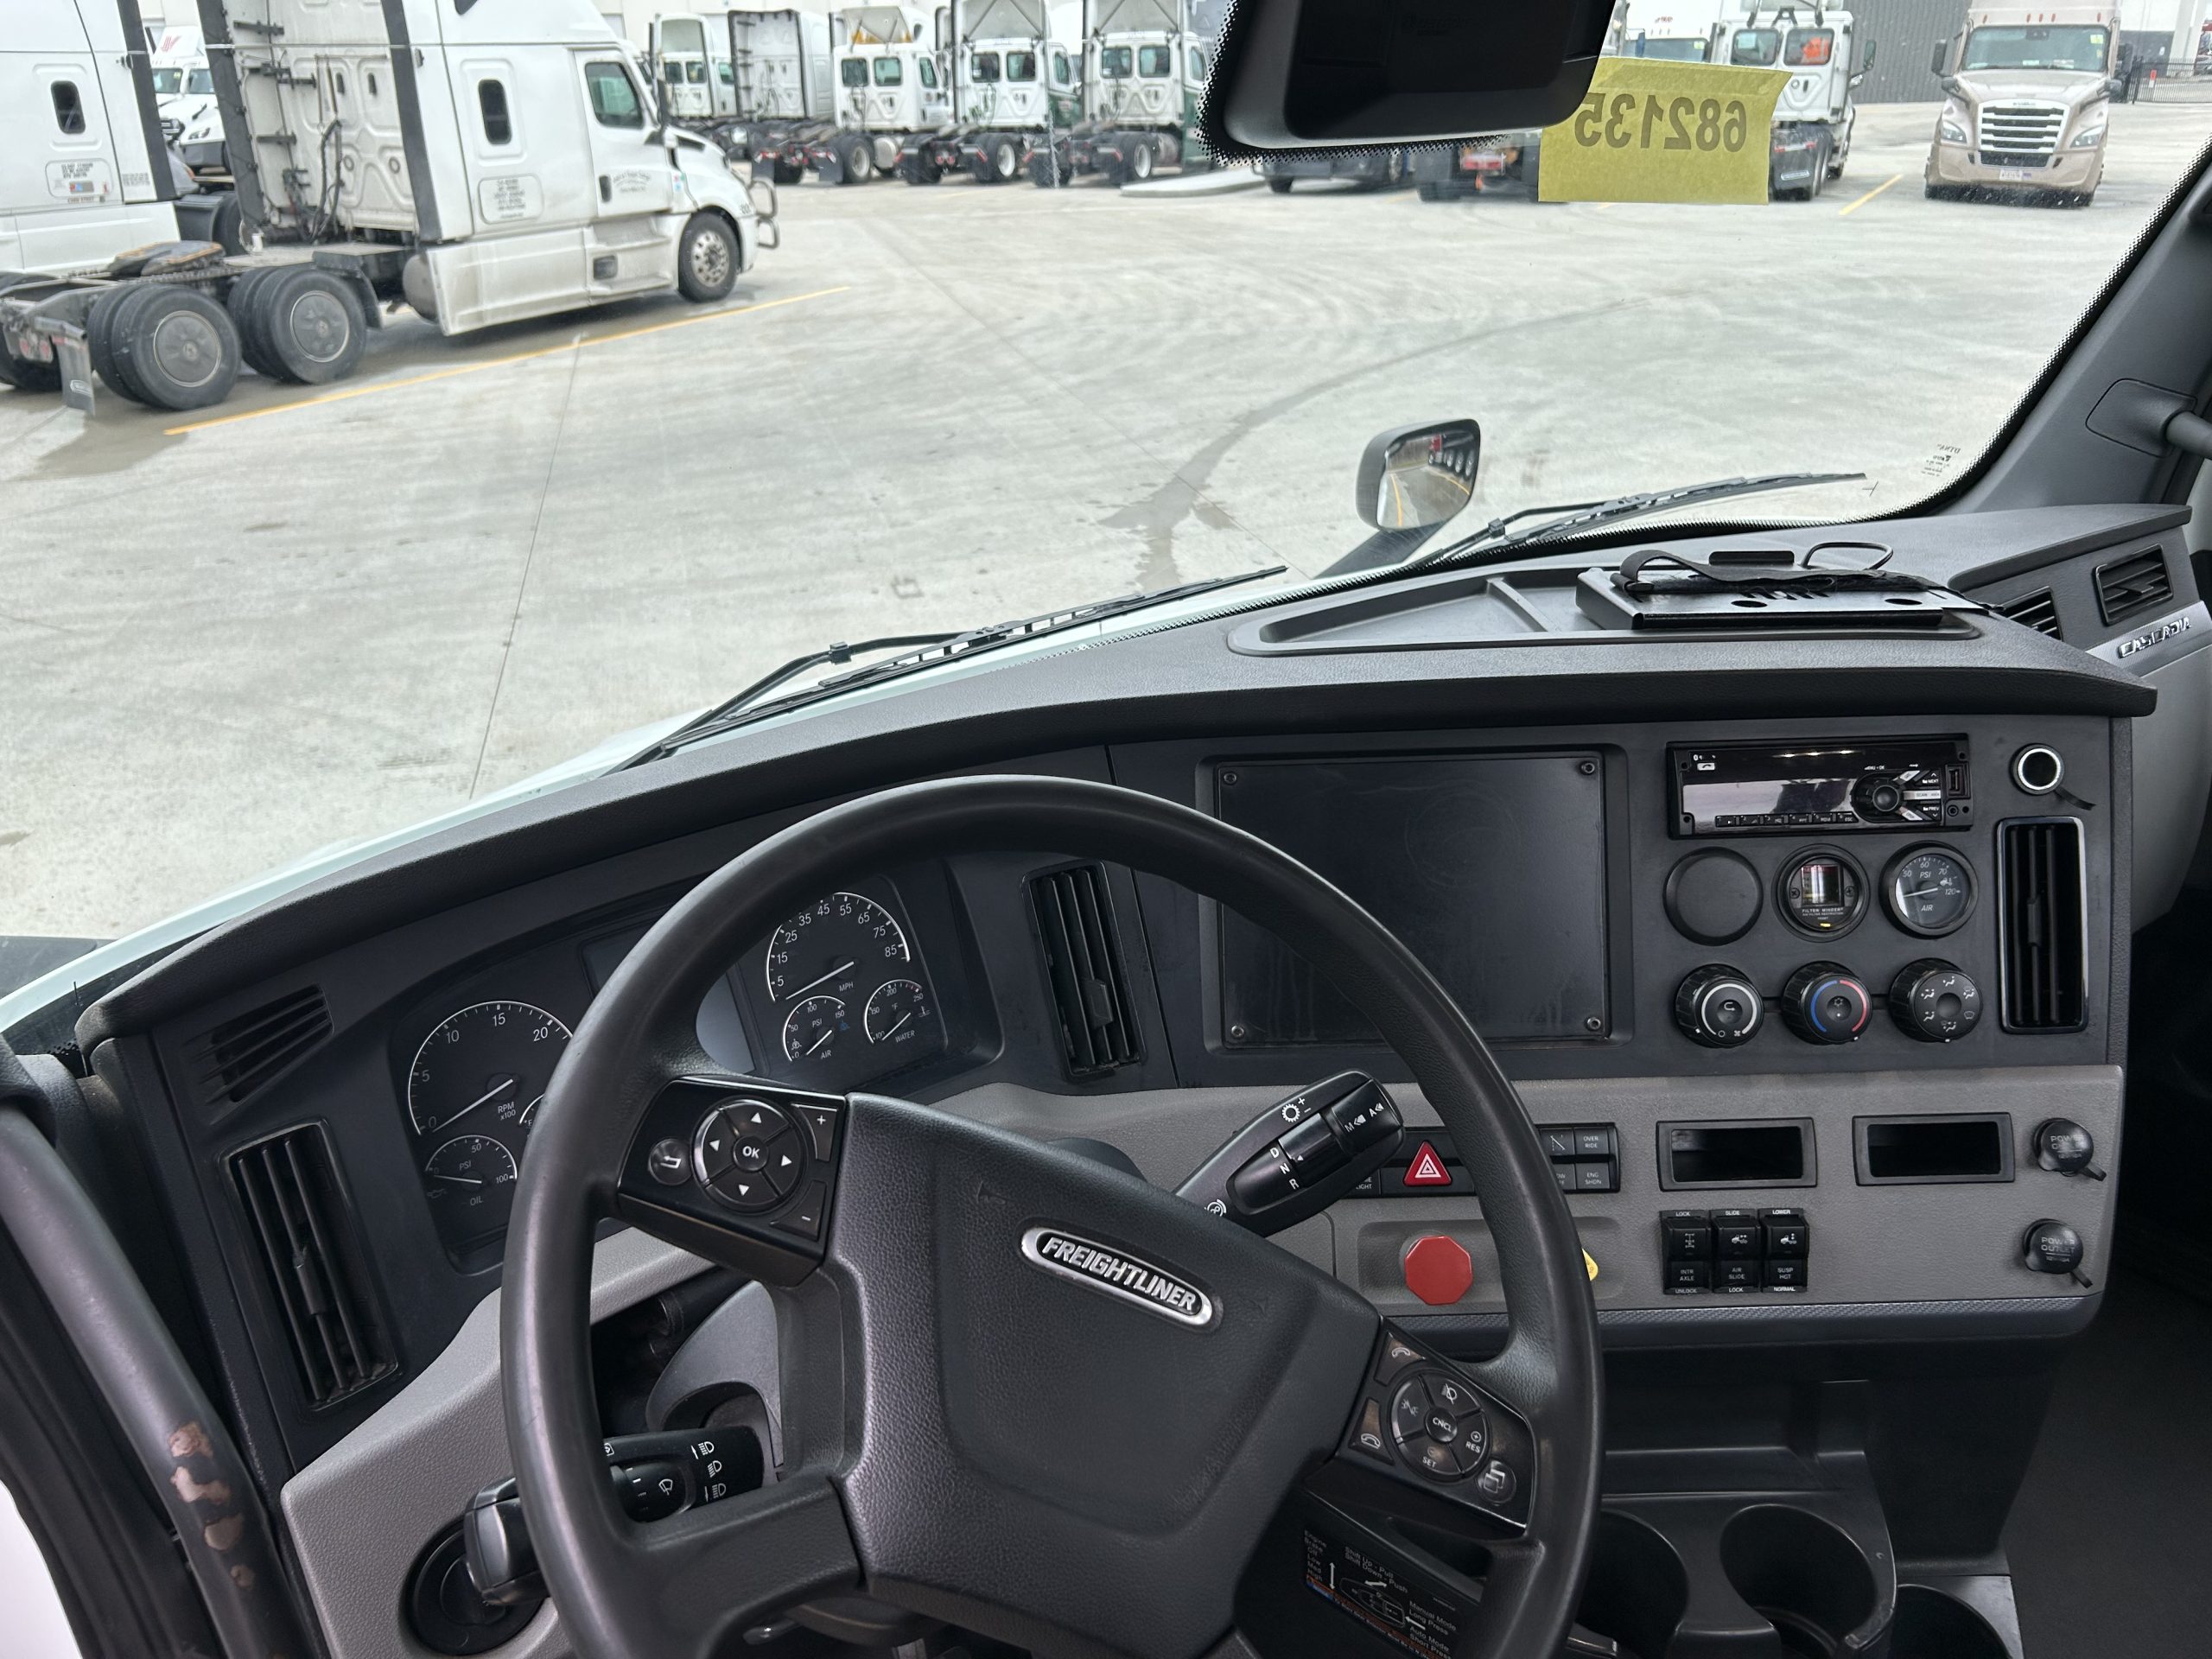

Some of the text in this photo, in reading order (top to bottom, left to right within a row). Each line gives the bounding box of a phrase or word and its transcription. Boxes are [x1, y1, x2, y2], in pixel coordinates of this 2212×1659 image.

[2120, 617, 2191, 657] CASCADIA
[817, 903, 830, 916] 45
[840, 903, 852, 916] 55
[798, 913, 811, 926] 35
[858, 912, 870, 924] 65
[785, 930, 798, 944] 25
[874, 925, 886, 938] 75
[885, 944, 897, 957] 85
[777, 951, 788, 964] 15
[777, 976, 785, 987] 5
[839, 982, 854, 992] MPH
[887, 987, 897, 996] 200
[913, 993, 924, 1002] 250
[807, 1004, 817, 1013] 100
[835, 1009, 845, 1019] 150
[870, 1007, 880, 1015] 150
[493, 1013, 506, 1027] 15
[812, 1019, 823, 1028] PSI
[446, 1030, 460, 1044] 10
[532, 1027, 549, 1042] 20
[895, 1029, 915, 1043] WATER
[820, 1050, 832, 1059] AIR
[422, 1070, 430, 1083] 5
[498, 1101, 515, 1113] RPM
[1369, 1108, 1376, 1117] A
[499, 1109, 517, 1120] x100
[429, 1116, 437, 1128] 0
[1344, 1122, 1355, 1132] M
[472, 1142, 482, 1153] 50
[742, 1146, 761, 1160] OK
[1270, 1147, 1279, 1159] D
[459, 1160, 472, 1171] PSI
[1280, 1163, 1290, 1174] N
[496, 1173, 509, 1184] 100
[1289, 1179, 1299, 1190] R
[470, 1196, 483, 1206] OIL
[1042, 1236, 1197, 1311] FREIGHTLINER
[1433, 1417, 1452, 1433] CNCL
[1465, 1441, 1481, 1453] RES
[1422, 1457, 1437, 1468] SET
[1307, 1554, 1320, 1566] Low
[1344, 1547, 1361, 1560] Shift
[1363, 1556, 1375, 1567] Up
[1379, 1567, 1393, 1579] Pull
[1344, 1553, 1361, 1567] Shift
[1362, 1562, 1382, 1579] Down
[1389, 1579, 1408, 1593] Push
[1409, 1600, 1435, 1619] Manual
[1436, 1616, 1457, 1631] Mode
[1409, 1610, 1449, 1635] Long Press
[1410, 1627, 1427, 1640] Auto
[1428, 1637, 1450, 1651] Mode
[1410, 1634, 1429, 1648] Short
